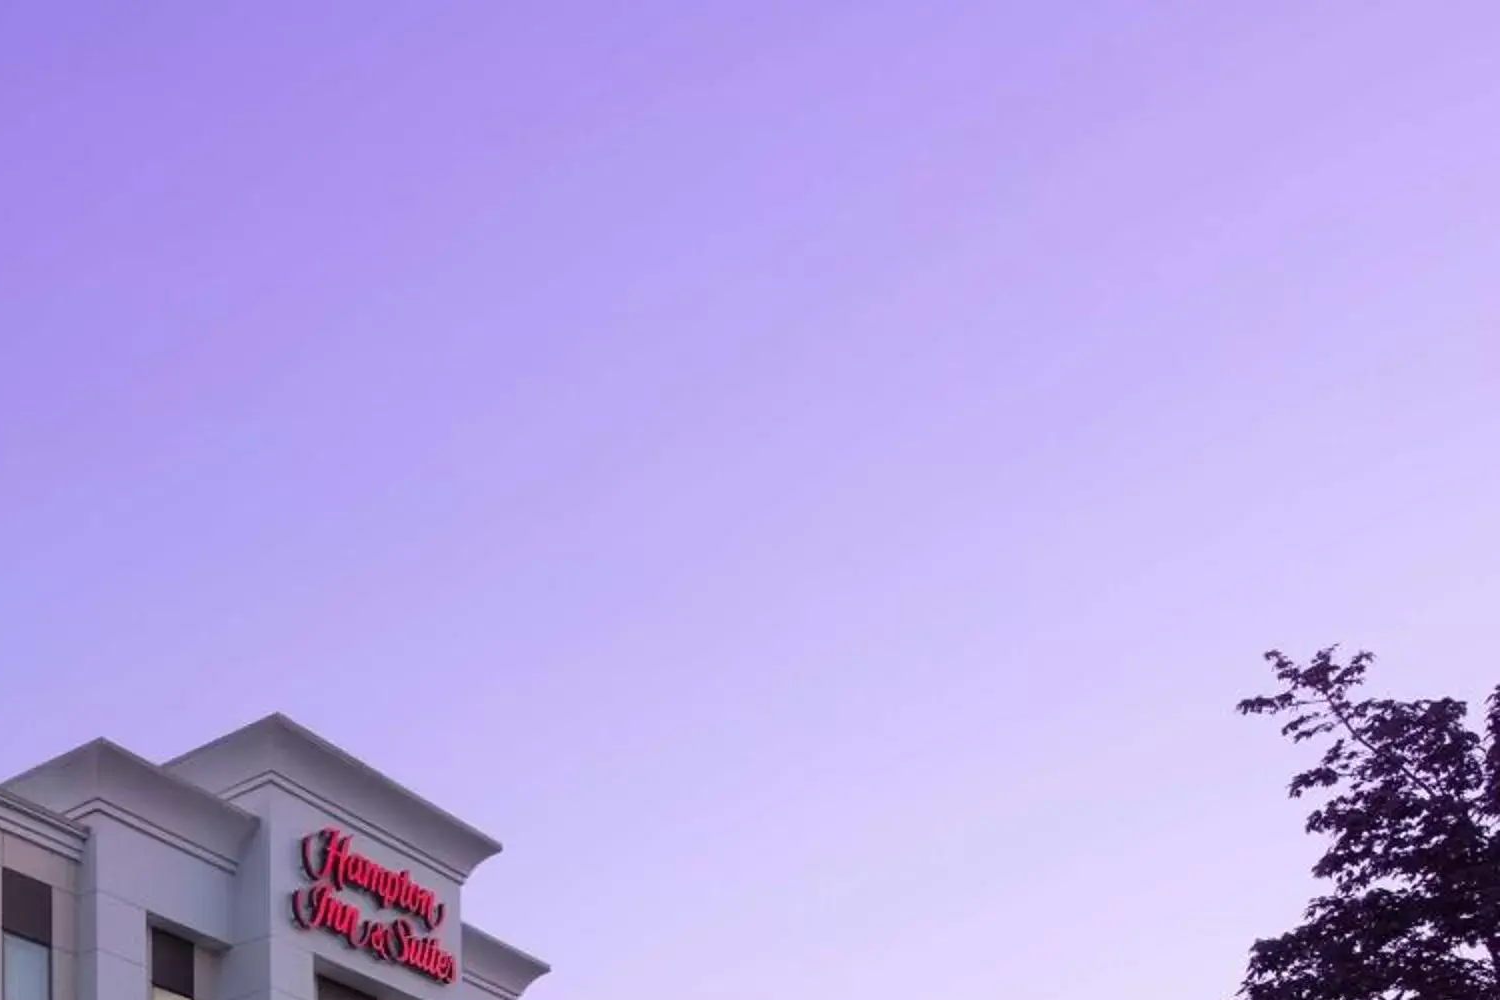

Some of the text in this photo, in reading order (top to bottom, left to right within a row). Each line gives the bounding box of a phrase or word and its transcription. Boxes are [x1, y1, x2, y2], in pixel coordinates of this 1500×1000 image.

[302, 827, 444, 931] Hampton
[291, 884, 456, 985] Inn & Suites
